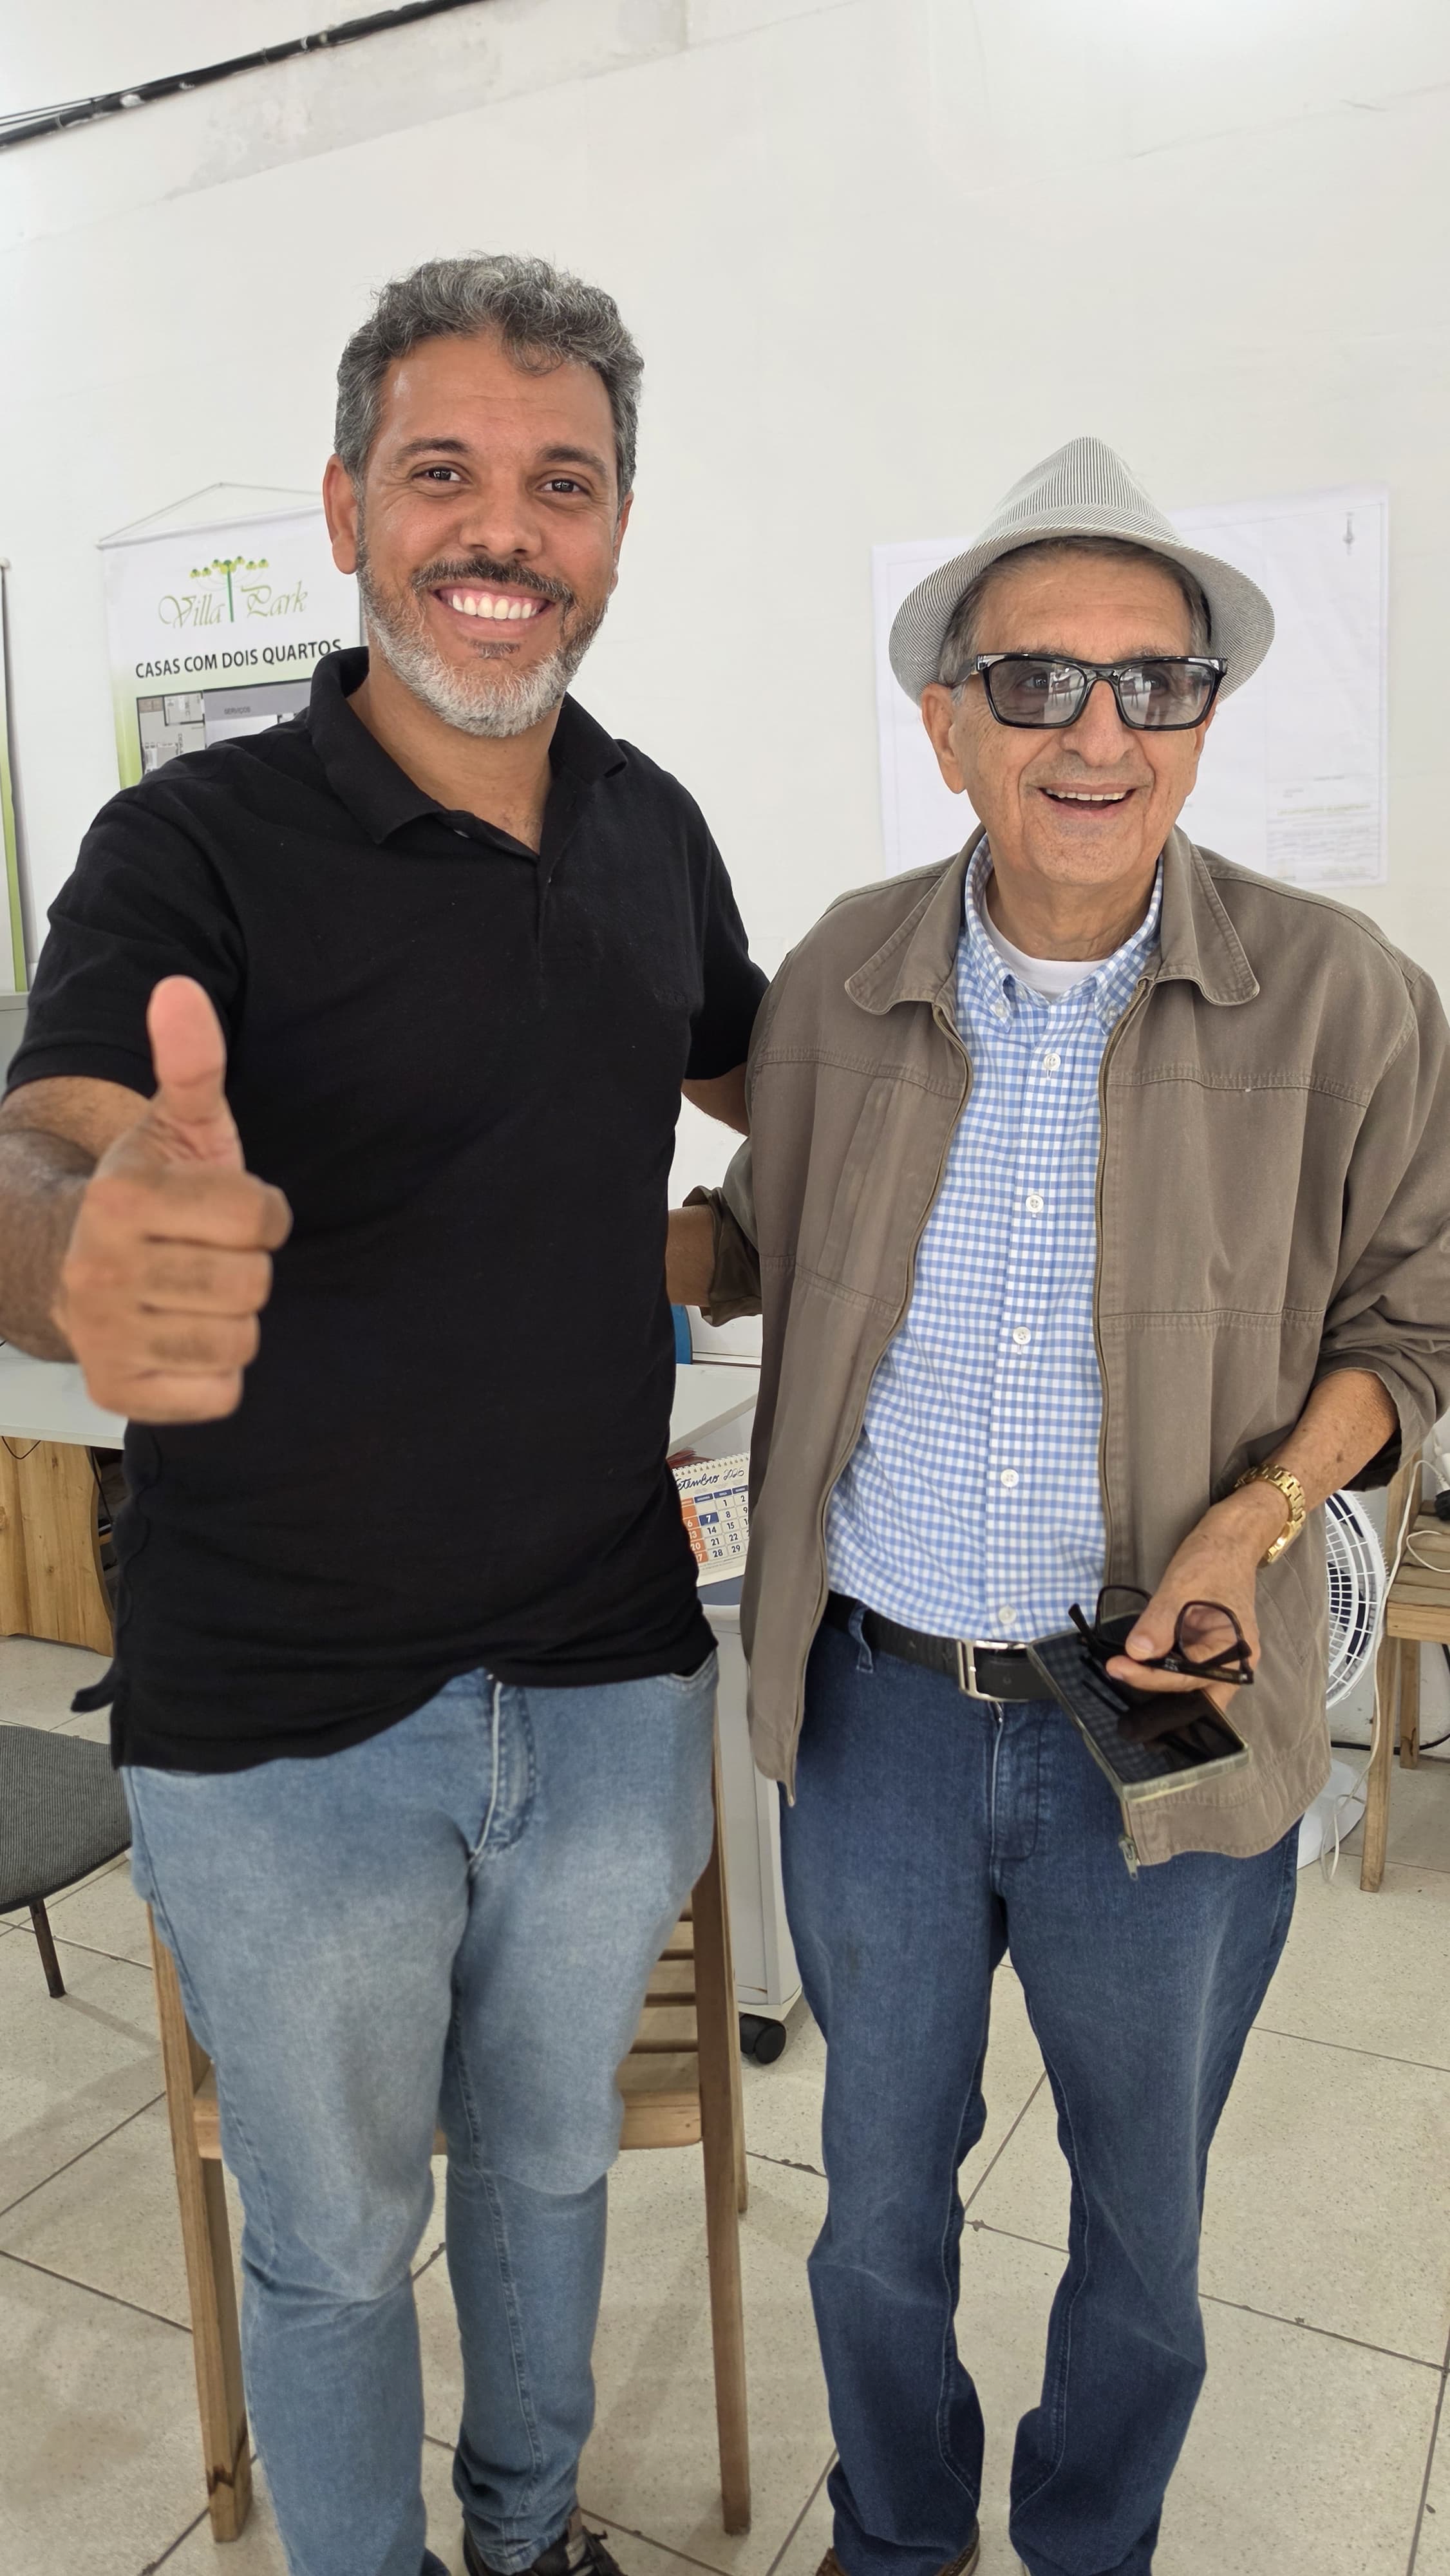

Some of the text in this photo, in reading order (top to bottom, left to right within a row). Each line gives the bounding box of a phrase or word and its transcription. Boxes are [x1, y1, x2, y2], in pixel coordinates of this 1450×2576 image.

[158, 580, 308, 629] Villa Park
[135, 638, 342, 679] CASAS COM DOIS QUARTOS
[676, 1473, 720, 1491] etembro
[706, 1515, 711, 1523] 7
[727, 1522, 735, 1530] 15
[690, 1542, 701, 1551] 20
[729, 1533, 738, 1542] 22
[731, 1544, 740, 1553] 29
